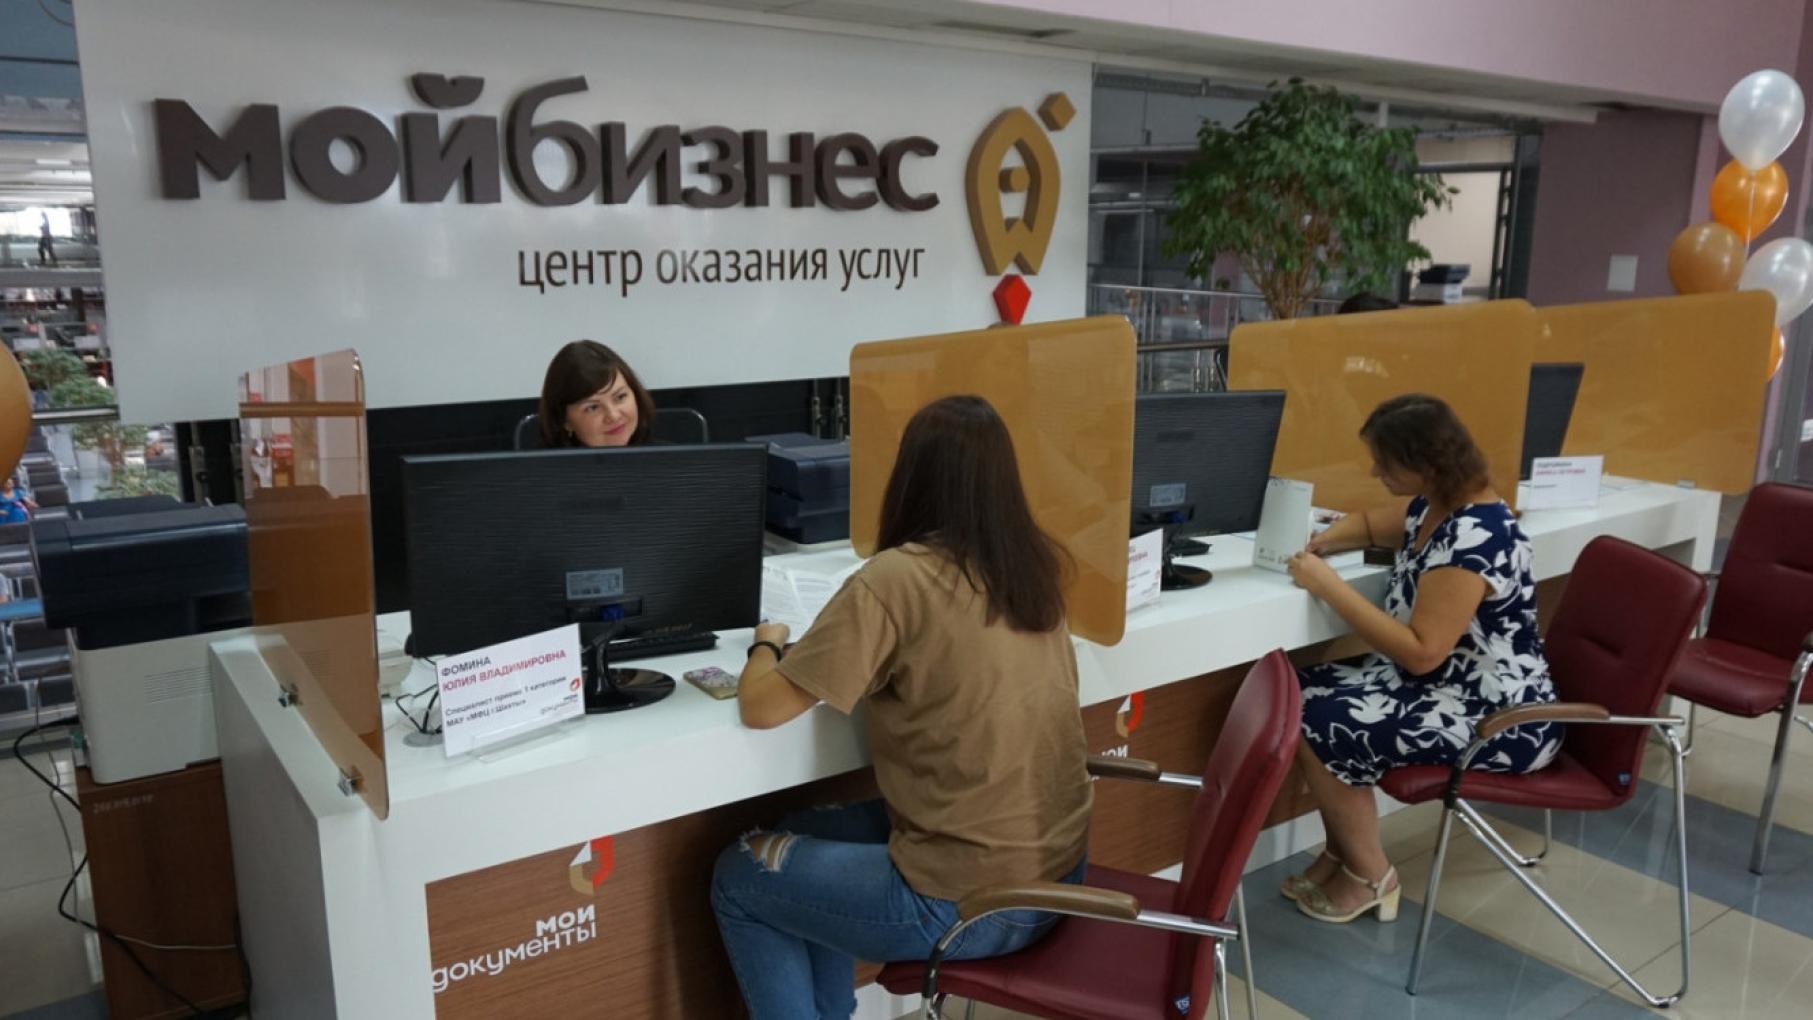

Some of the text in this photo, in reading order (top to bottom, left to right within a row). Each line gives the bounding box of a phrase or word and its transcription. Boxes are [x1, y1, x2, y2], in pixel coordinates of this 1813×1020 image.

[518, 246, 925, 297] центр оказания услуг
[441, 656, 491, 677] ФОМИНА
[442, 650, 567, 691] ЮЛИЯ ВЛАДИМИРОВНА
[1101, 744, 1129, 758] ои
[536, 904, 595, 937] мои
[432, 921, 597, 993] документы
